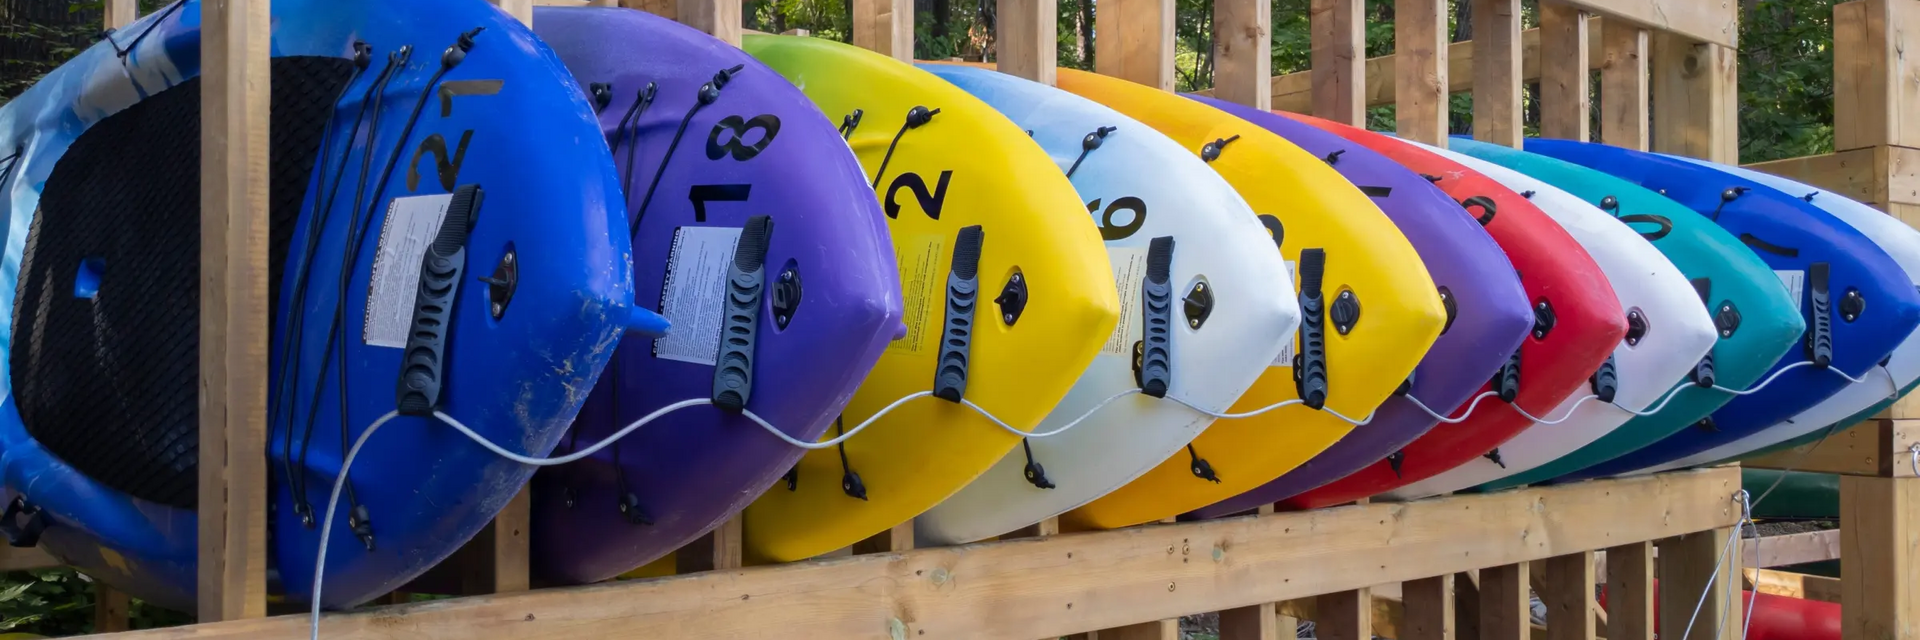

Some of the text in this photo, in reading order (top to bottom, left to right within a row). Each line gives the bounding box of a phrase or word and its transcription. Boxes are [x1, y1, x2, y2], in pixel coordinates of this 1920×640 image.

[405, 79, 504, 193] 21
[688, 113, 781, 222] 18
[378, 202, 394, 248] WARNING
[884, 170, 953, 220] 2
[1086, 196, 1147, 241] 6
[660, 272, 670, 307] SAFETY
[667, 229, 680, 271] WARNING
